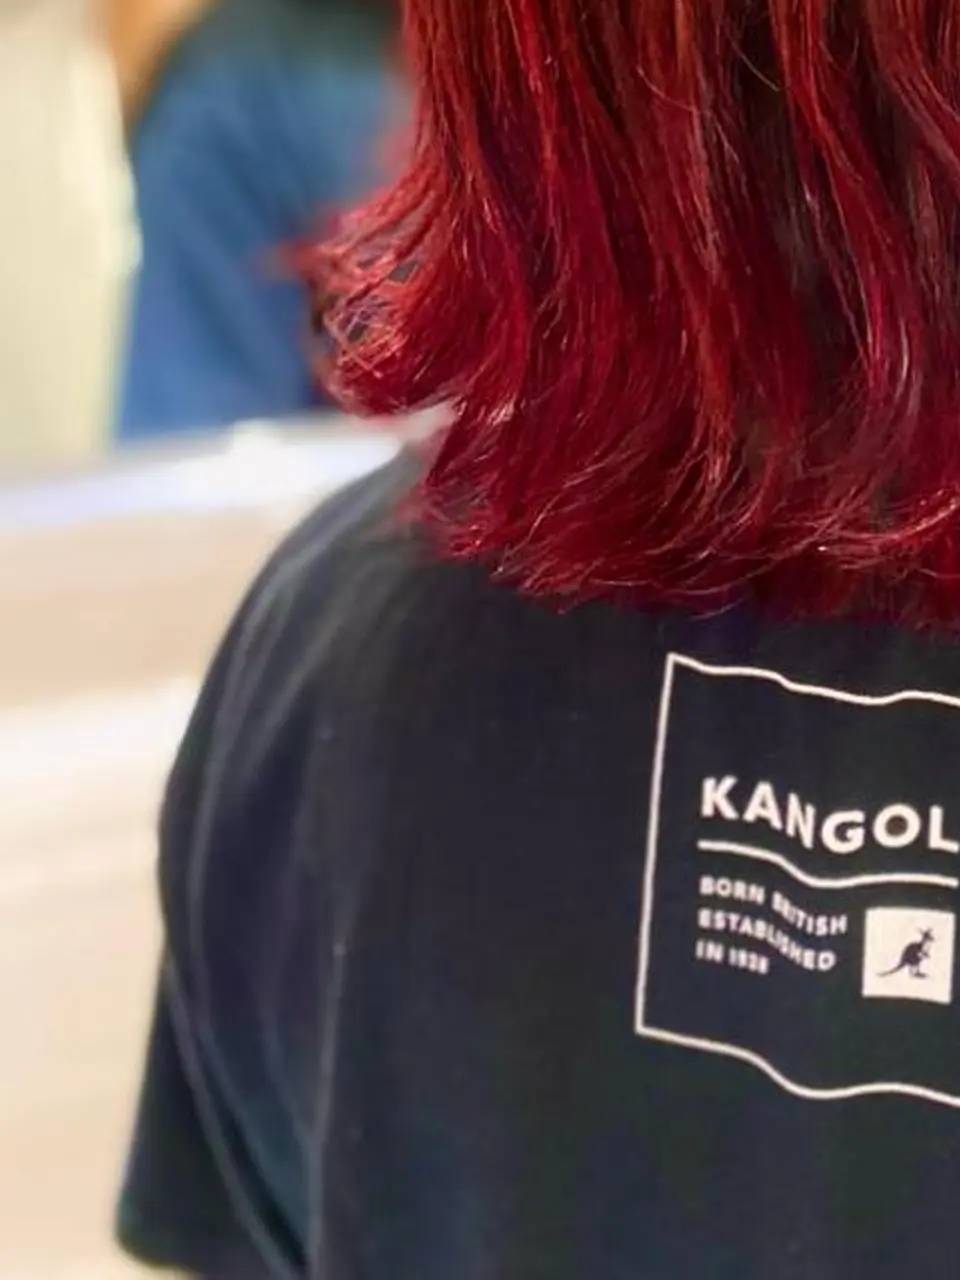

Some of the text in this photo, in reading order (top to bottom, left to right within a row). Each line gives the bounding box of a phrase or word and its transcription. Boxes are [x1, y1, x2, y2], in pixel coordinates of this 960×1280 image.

[701, 775, 960, 854] KANGOL
[699, 875, 847, 936] BORN BRITISH
[695, 940, 724, 963] IN
[698, 910, 836, 971] ESTABLISHED
